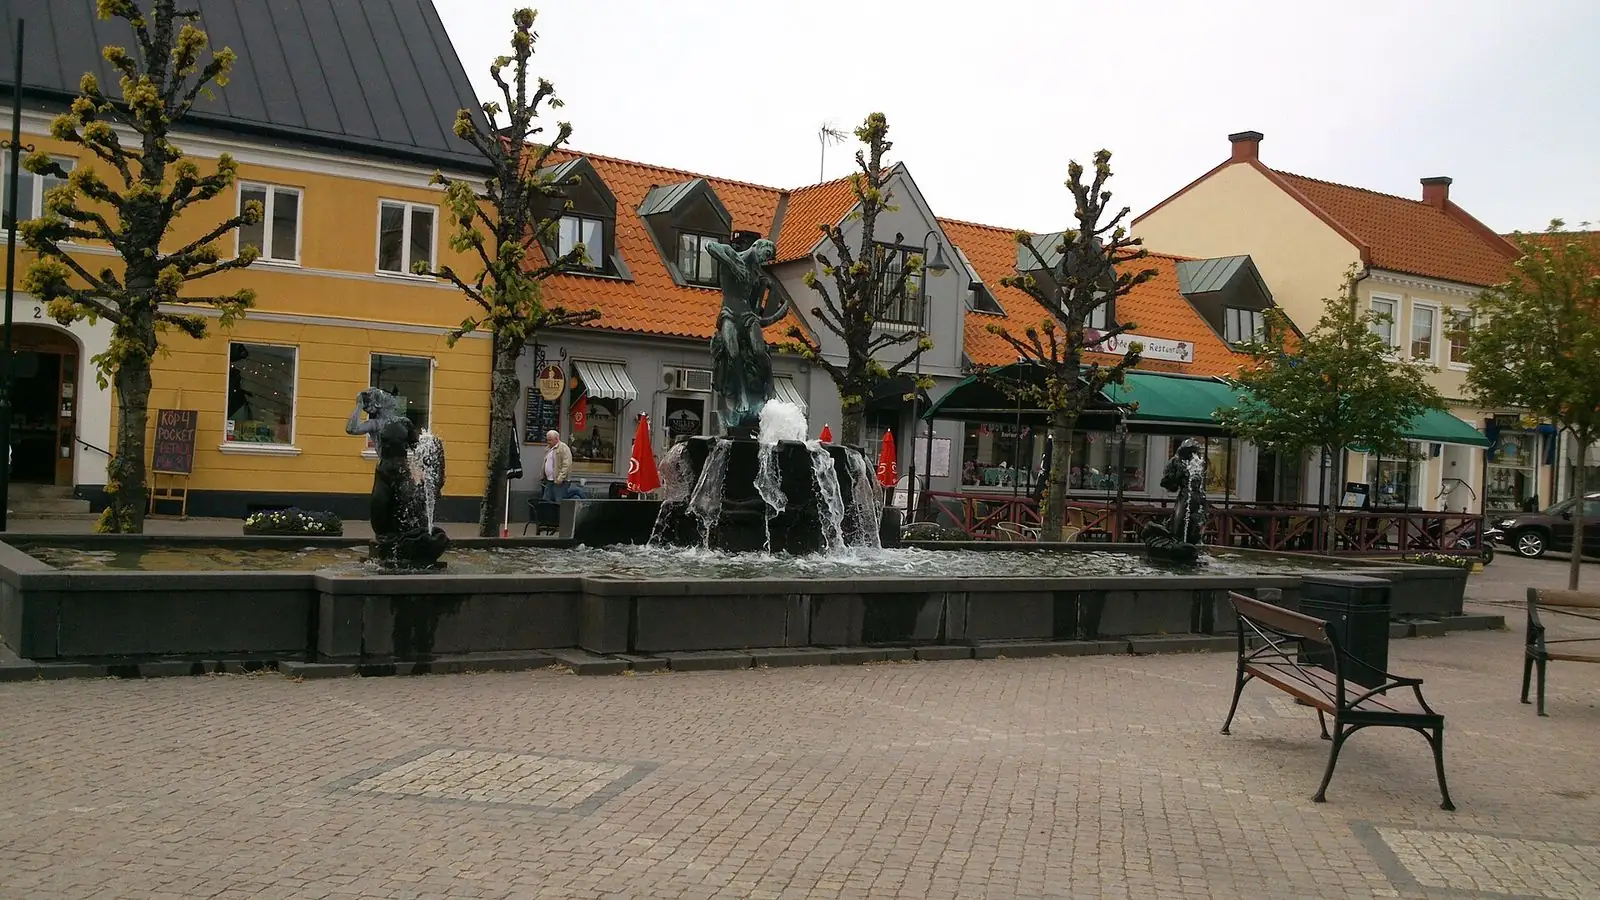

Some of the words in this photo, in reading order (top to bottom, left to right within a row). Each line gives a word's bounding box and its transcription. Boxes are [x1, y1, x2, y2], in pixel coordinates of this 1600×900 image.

[34, 307, 41, 318] 2
[181, 411, 190, 428] 4
[158, 427, 194, 441] POCKET
